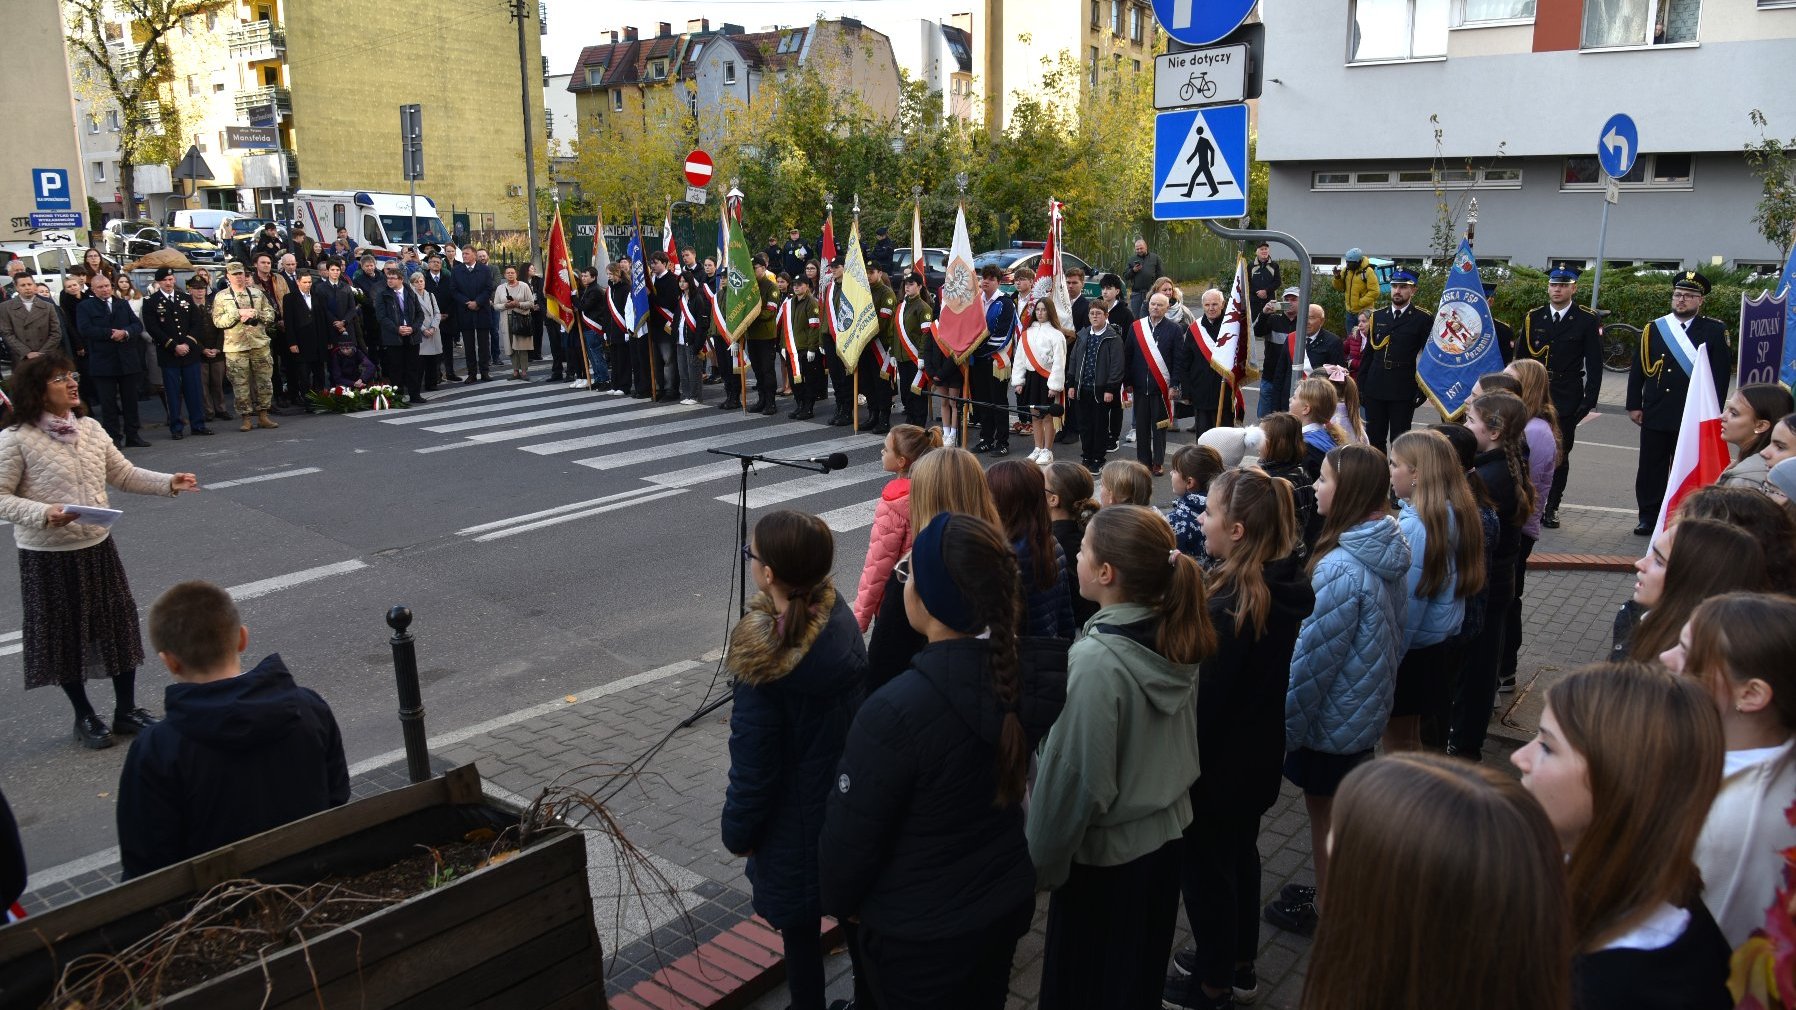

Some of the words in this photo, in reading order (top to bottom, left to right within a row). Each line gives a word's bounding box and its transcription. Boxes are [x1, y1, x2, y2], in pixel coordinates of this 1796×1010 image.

[1168, 57, 1186, 68] Nie
[1190, 52, 1231, 66] dotyczy
[232, 133, 271, 142] Mansfelda
[40, 172, 61, 197] P
[1463, 292, 1479, 304] PSP
[1749, 311, 1781, 338] POZNAŃ
[1464, 332, 1491, 361] Poznaniu
[1757, 341, 1770, 364] SP
[1445, 381, 1463, 400] 1877
